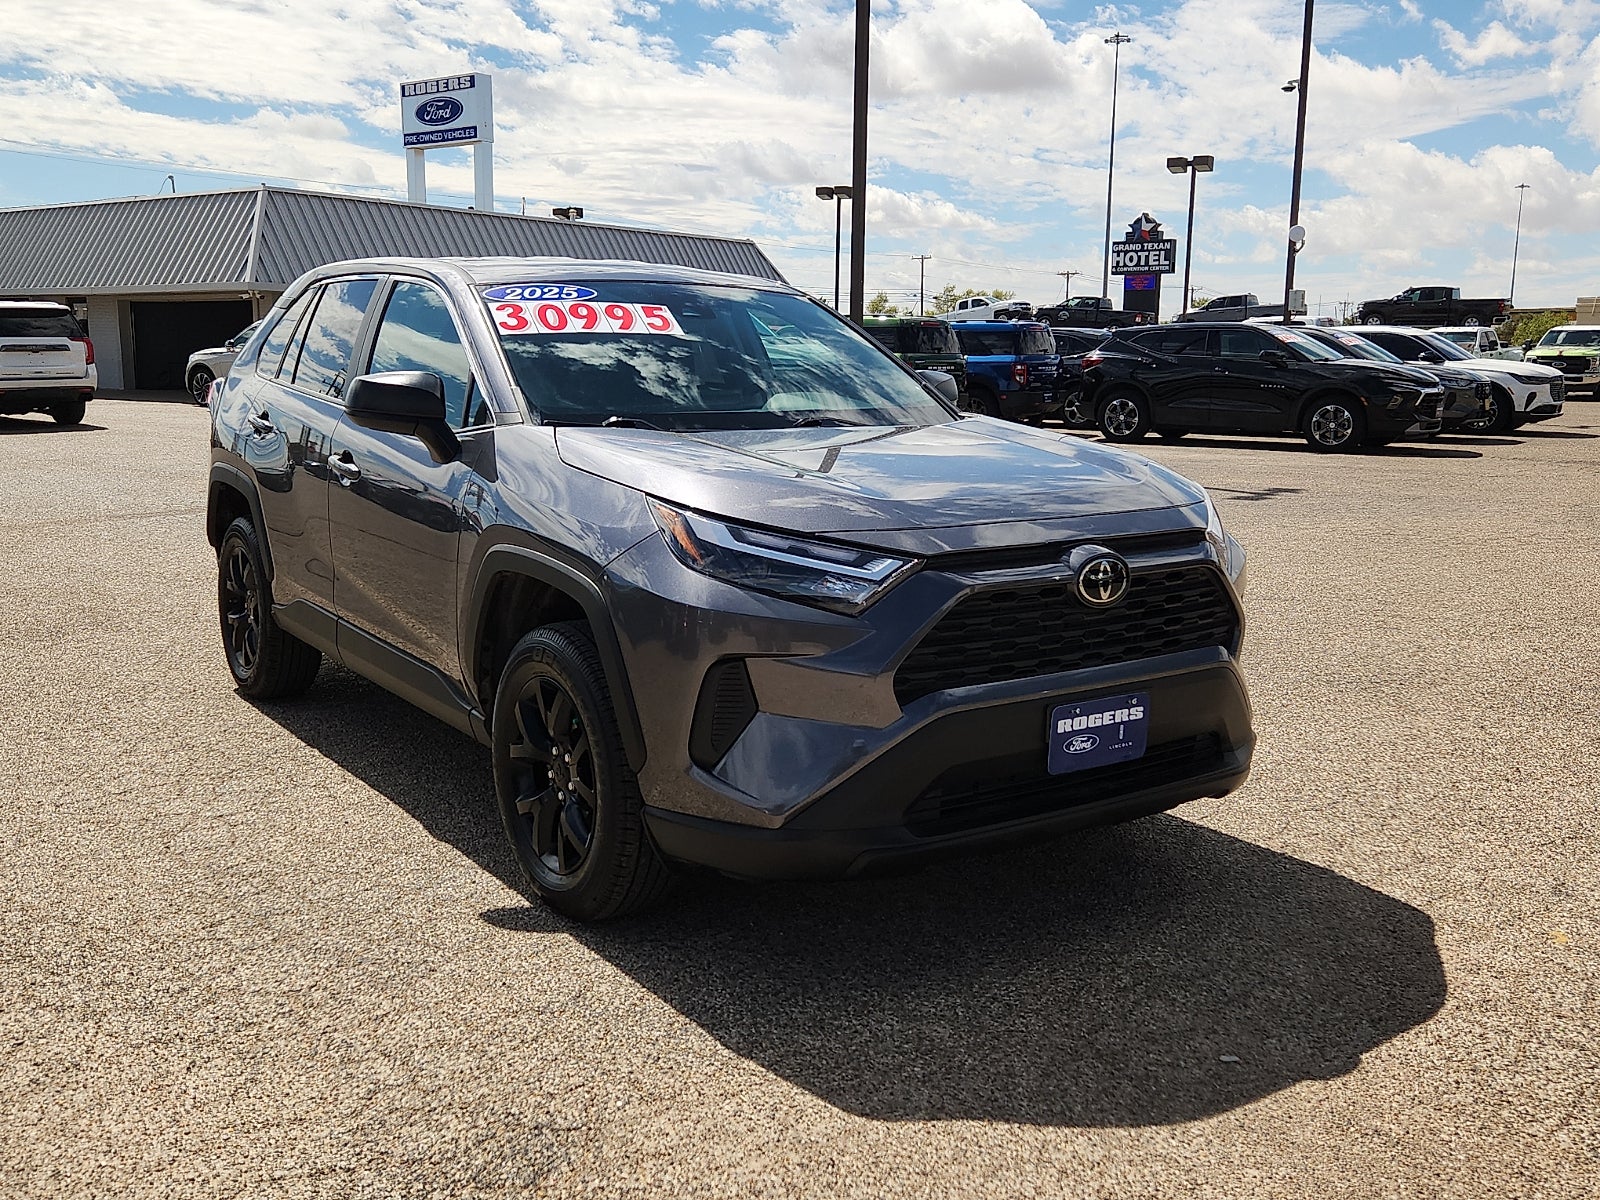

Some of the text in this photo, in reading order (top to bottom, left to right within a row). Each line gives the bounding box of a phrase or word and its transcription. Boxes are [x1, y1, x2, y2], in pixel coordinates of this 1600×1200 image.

[404, 76, 471, 96] ROGERS
[424, 101, 452, 120] Ford
[405, 128, 475, 143] PRE-OWNED VEHICLES
[1113, 242, 1171, 252] GRAND TEXAN
[1112, 251, 1170, 267] HOTEL
[503, 286, 580, 300] 2025
[495, 303, 675, 331] 30995
[1057, 706, 1145, 734] ROGERS
[1069, 737, 1093, 752] Ford
